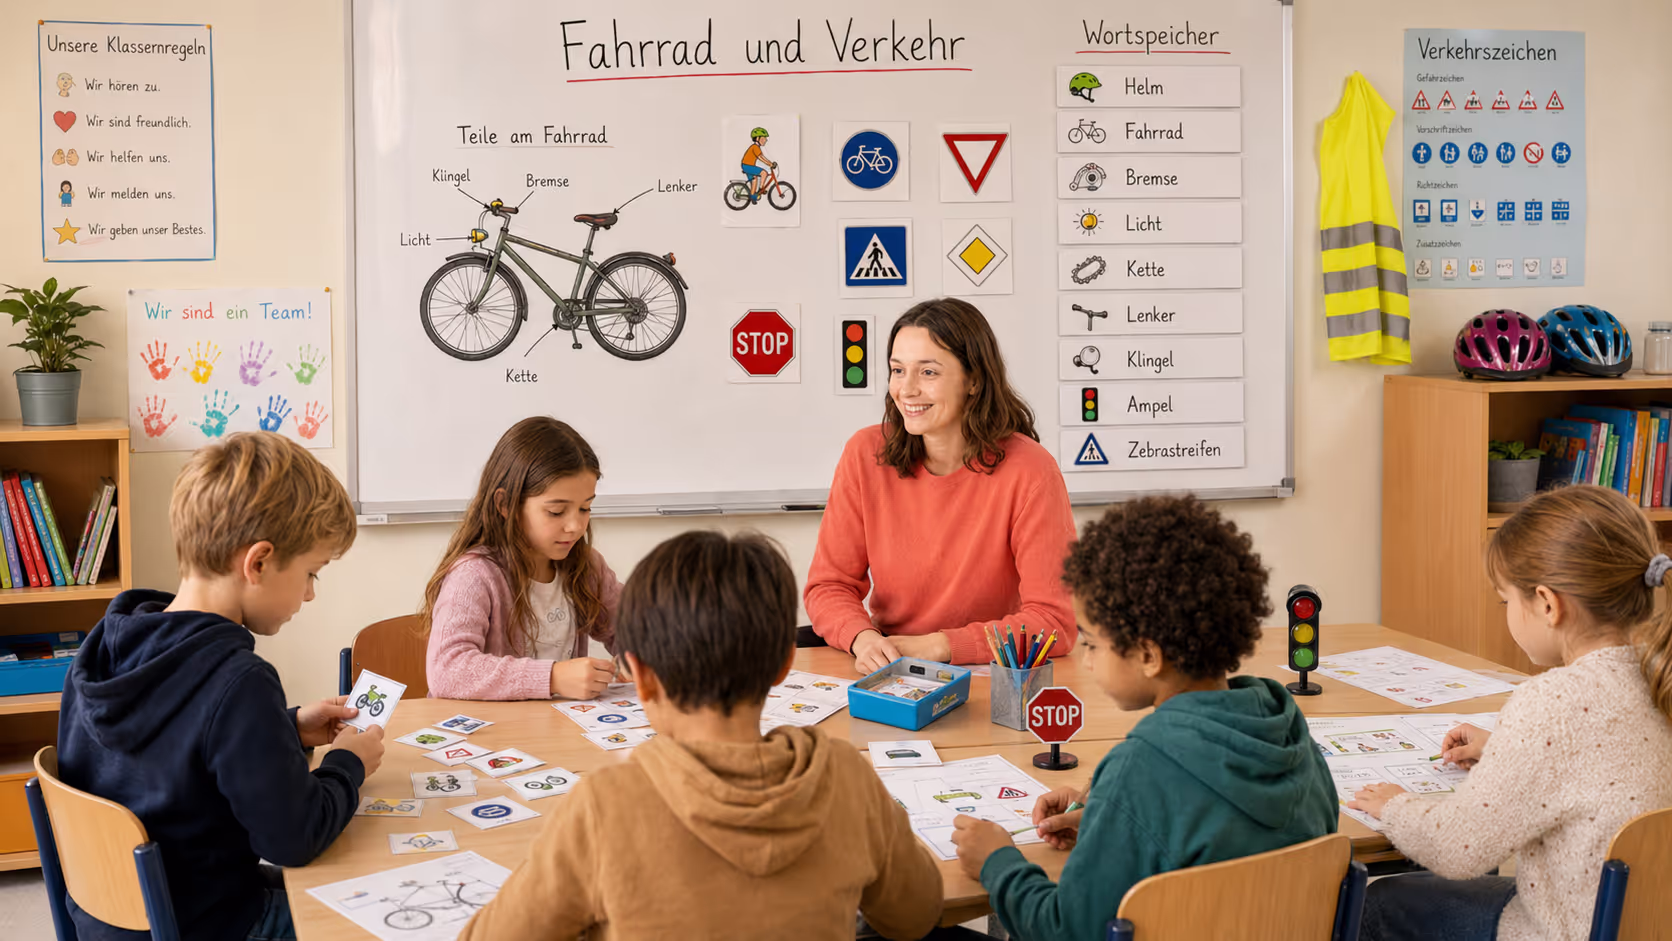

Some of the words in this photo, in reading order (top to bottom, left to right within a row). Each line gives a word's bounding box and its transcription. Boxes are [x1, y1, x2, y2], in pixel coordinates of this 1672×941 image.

[559, 17, 717, 71] Fahrrad
[745, 18, 806, 64] und
[825, 17, 966, 63] Verkehr
[1082, 19, 1220, 56] Wortspeicher
[47, 34, 99, 53] Unsere
[107, 35, 206, 62] Klassernregeln
[1417, 37, 1557, 61] Verkehrszeichen
[84, 77, 104, 91] Wir
[108, 78, 139, 92] hören
[144, 83, 161, 92] zu.
[1125, 76, 1164, 96] Helm
[85, 114, 104, 127] Wir
[108, 115, 132, 128] sind
[136, 114, 192, 128] freundlich.
[456, 125, 498, 145] Teile
[510, 132, 533, 144] am
[543, 125, 608, 144] Fahrrad
[1125, 121, 1184, 140] Fahrrad
[86, 150, 105, 163] Wir
[110, 149, 144, 163] helfen
[149, 154, 171, 163] uns.
[526, 173, 570, 188] Bremse
[658, 178, 698, 193] Lenker
[1126, 168, 1178, 186] Bremse
[87, 186, 106, 199] Wir
[111, 187, 149, 200] melden
[154, 191, 176, 200] uns.
[87, 223, 106, 235] Wir
[109, 223, 139, 241] geben
[142, 226, 169, 235] unser
[172, 223, 207, 235] Bestes.
[1126, 214, 1163, 232] Licht
[400, 232, 432, 247] Licht
[1127, 259, 1165, 277] Kette
[144, 301, 172, 320] Wir
[182, 301, 215, 320] sind
[226, 304, 249, 320] ein
[259, 301, 312, 320] Team!
[1127, 305, 1176, 323] Lenker
[736, 331, 789, 356] STOP
[1127, 350, 1174, 374] Klingel
[506, 368, 538, 383] Kette
[1127, 395, 1173, 419] Ampel
[1128, 439, 1221, 459] Zebrastreifen
[1031, 704, 1081, 730] STOP
